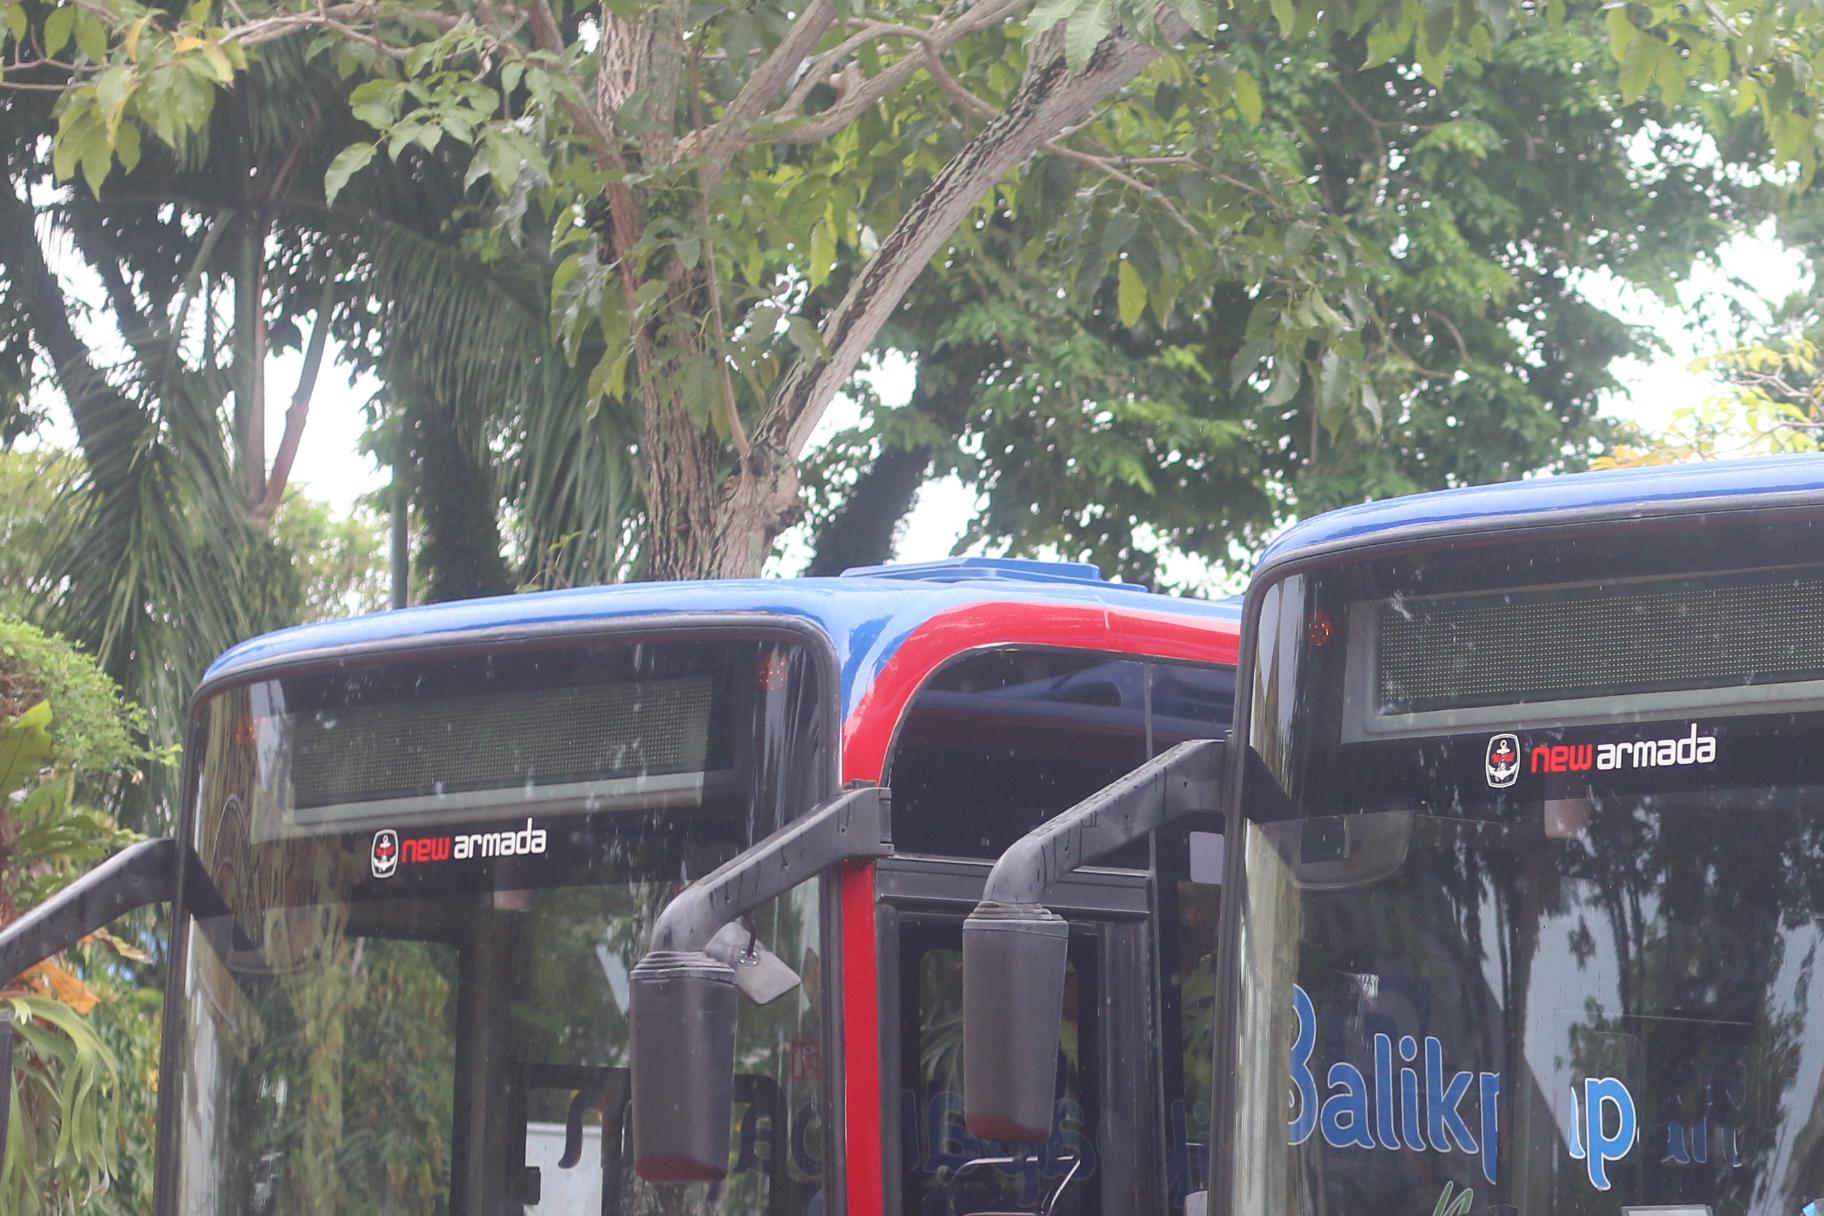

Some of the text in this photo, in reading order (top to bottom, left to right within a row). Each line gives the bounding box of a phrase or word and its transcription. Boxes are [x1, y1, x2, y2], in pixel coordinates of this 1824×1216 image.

[1530, 722, 1717, 774] new armada
[401, 816, 548, 864] new armada
